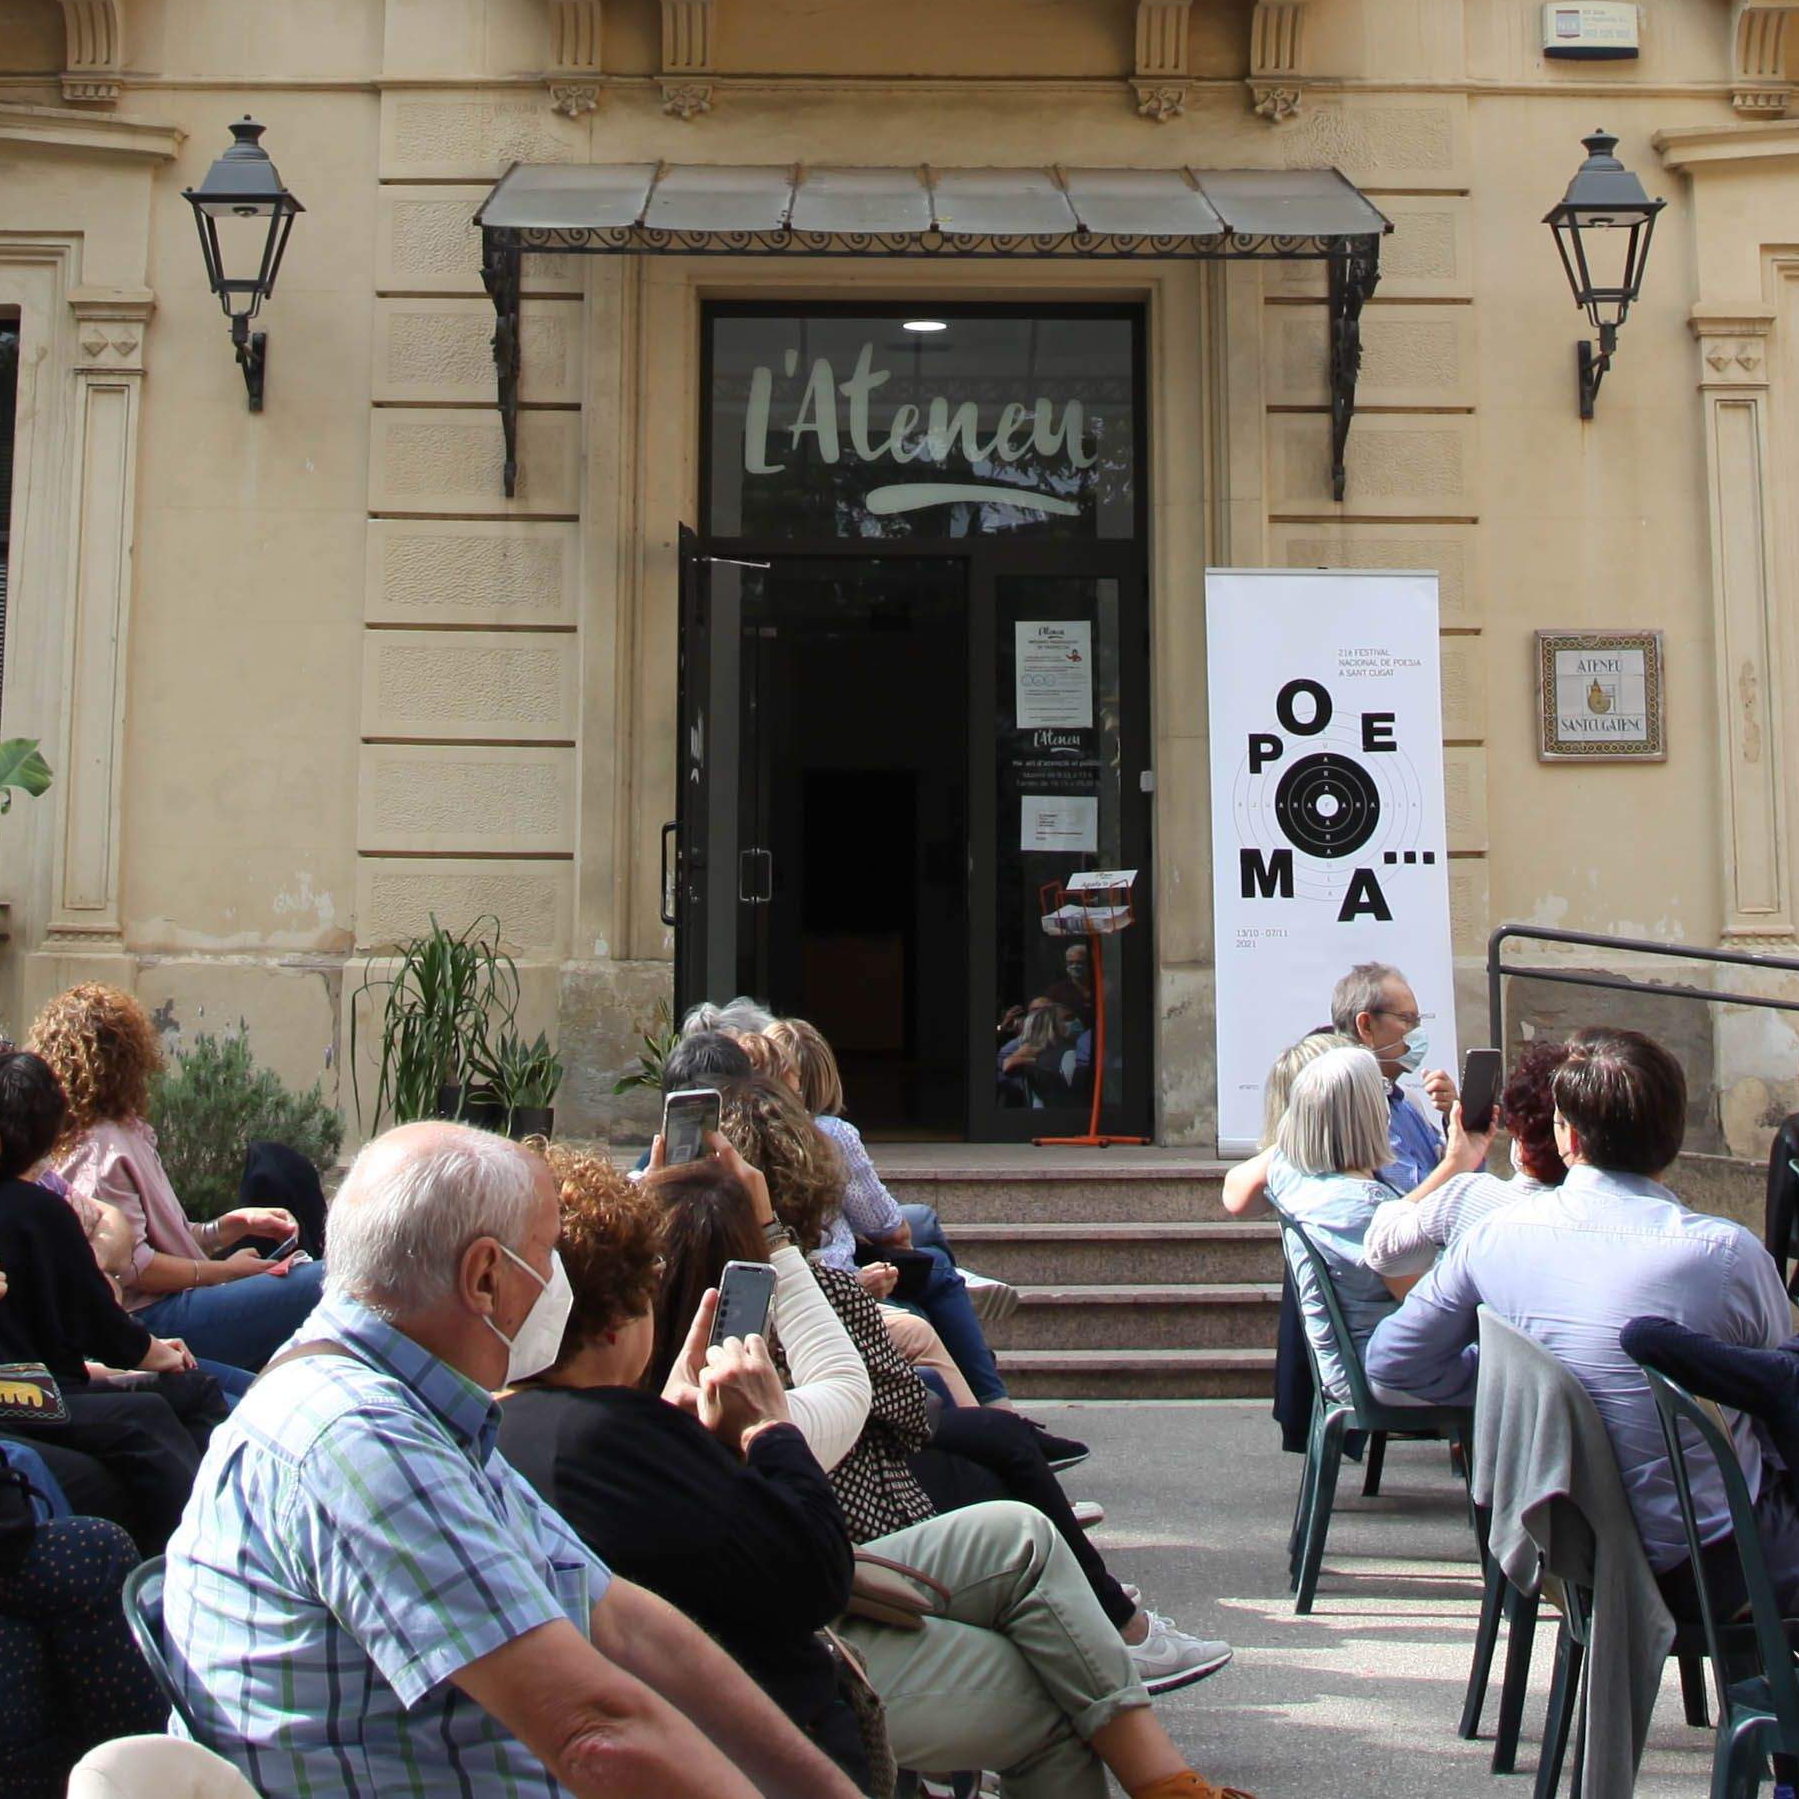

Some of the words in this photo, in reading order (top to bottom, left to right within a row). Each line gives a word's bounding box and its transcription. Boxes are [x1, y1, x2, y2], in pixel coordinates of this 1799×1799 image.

[744, 342, 1098, 475] L'Ateneu
[1354, 648, 1391, 657] FESTIVAL
[1338, 659, 1379, 667] NACIONAL
[1381, 659, 1392, 667] DE
[1393, 659, 1422, 667] POESIA
[1576, 658, 1624, 674] ATENEU
[1346, 669, 1366, 677] SANT
[1368, 669, 1395, 677] CUGAT
[1033, 729, 1081, 747] L'Ateneu
[1236, 929, 1260, 937] 13/10
[1265, 929, 1289, 937] 07/11
[1235, 939, 1257, 948] 2021
